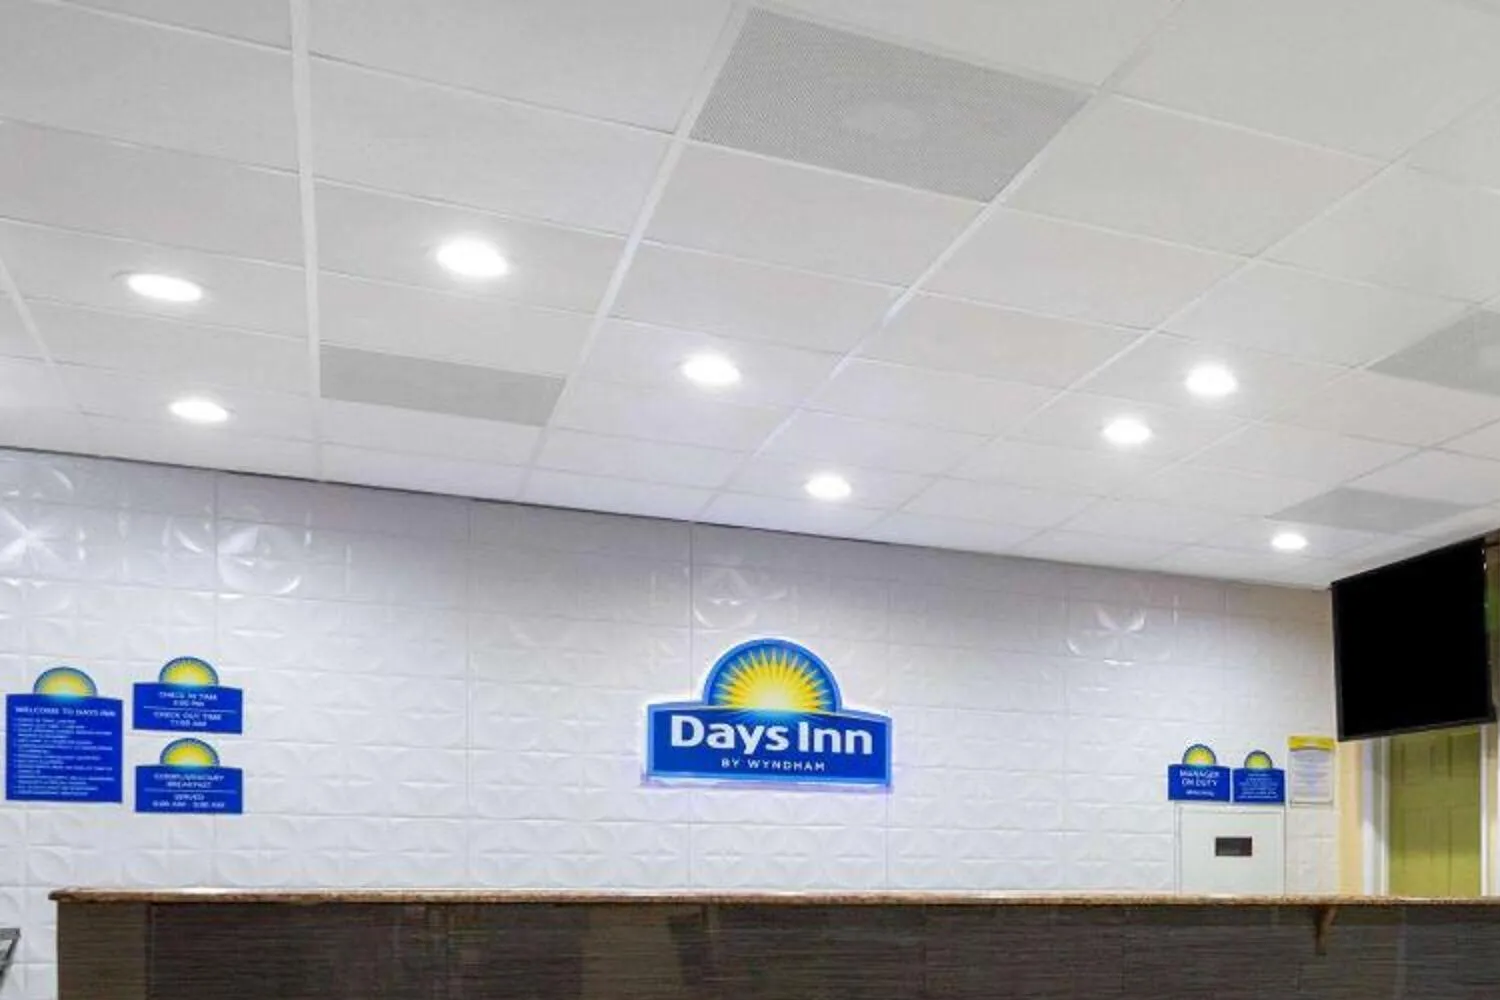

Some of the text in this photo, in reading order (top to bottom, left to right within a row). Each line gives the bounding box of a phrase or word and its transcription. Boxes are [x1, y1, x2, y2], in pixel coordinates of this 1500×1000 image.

[671, 715, 873, 755] Days Inn
[720, 757, 825, 772] BY WYNDHAM
[1179, 768, 1220, 778] MANAGER
